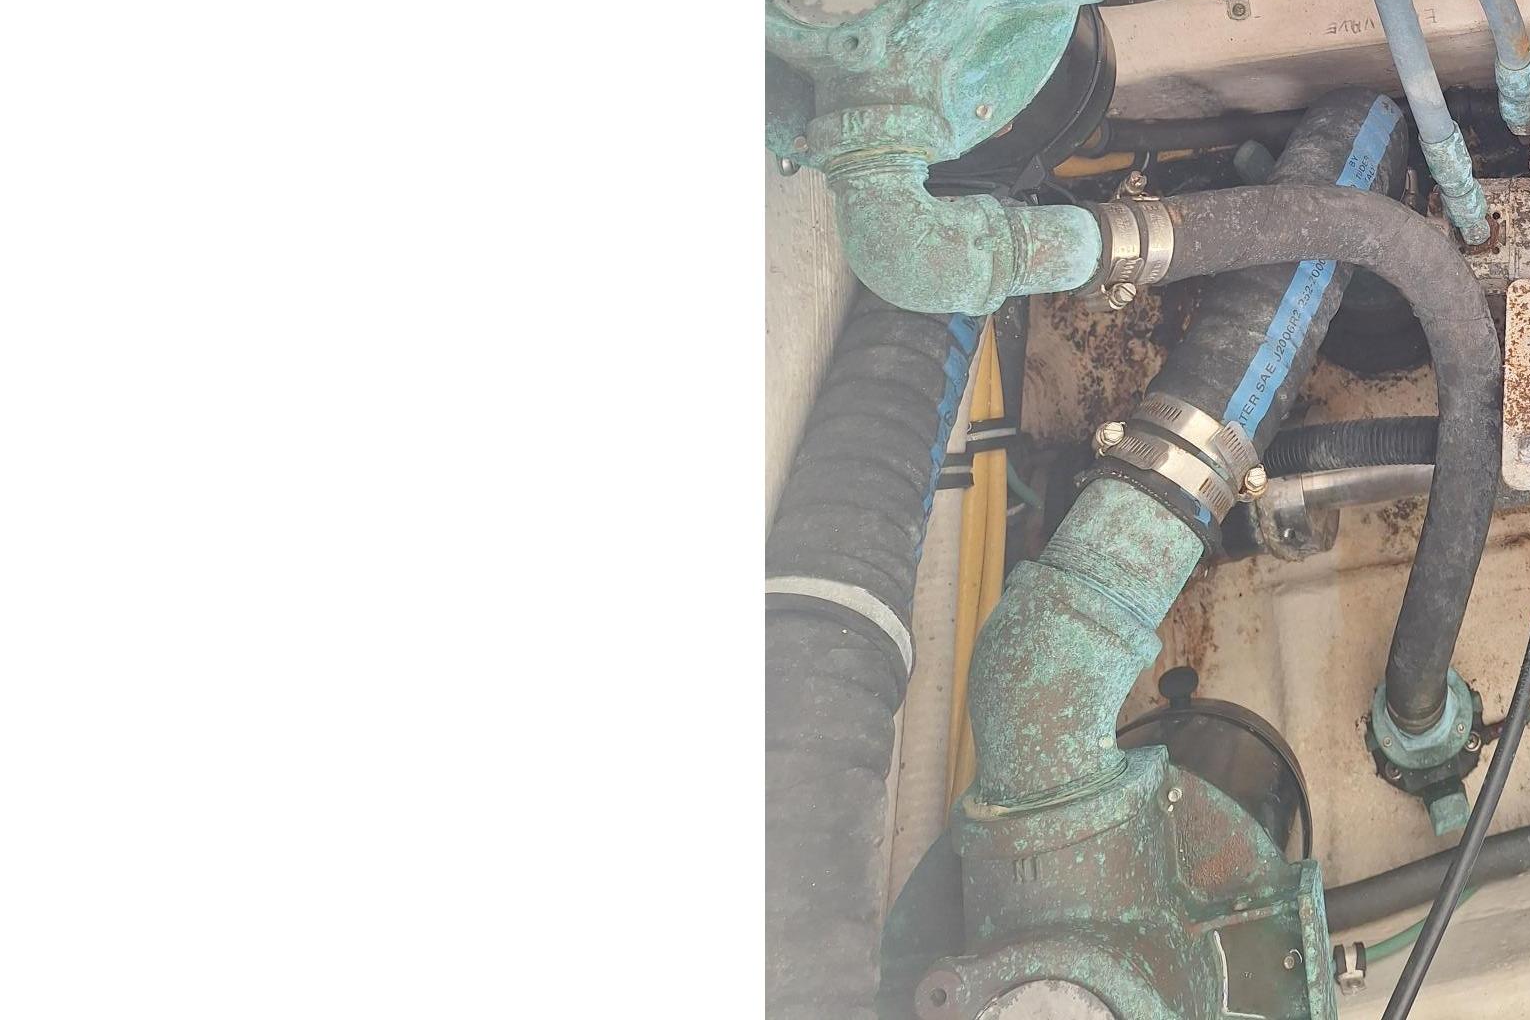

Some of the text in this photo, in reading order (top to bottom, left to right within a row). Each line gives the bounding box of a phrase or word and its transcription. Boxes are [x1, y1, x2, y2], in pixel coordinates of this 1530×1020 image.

[1348, 154, 1361, 168] BY
[1238, 395, 1262, 430] ATER
[1256, 361, 1276, 397] SAE
[1273, 309, 1303, 362] J2006R2
